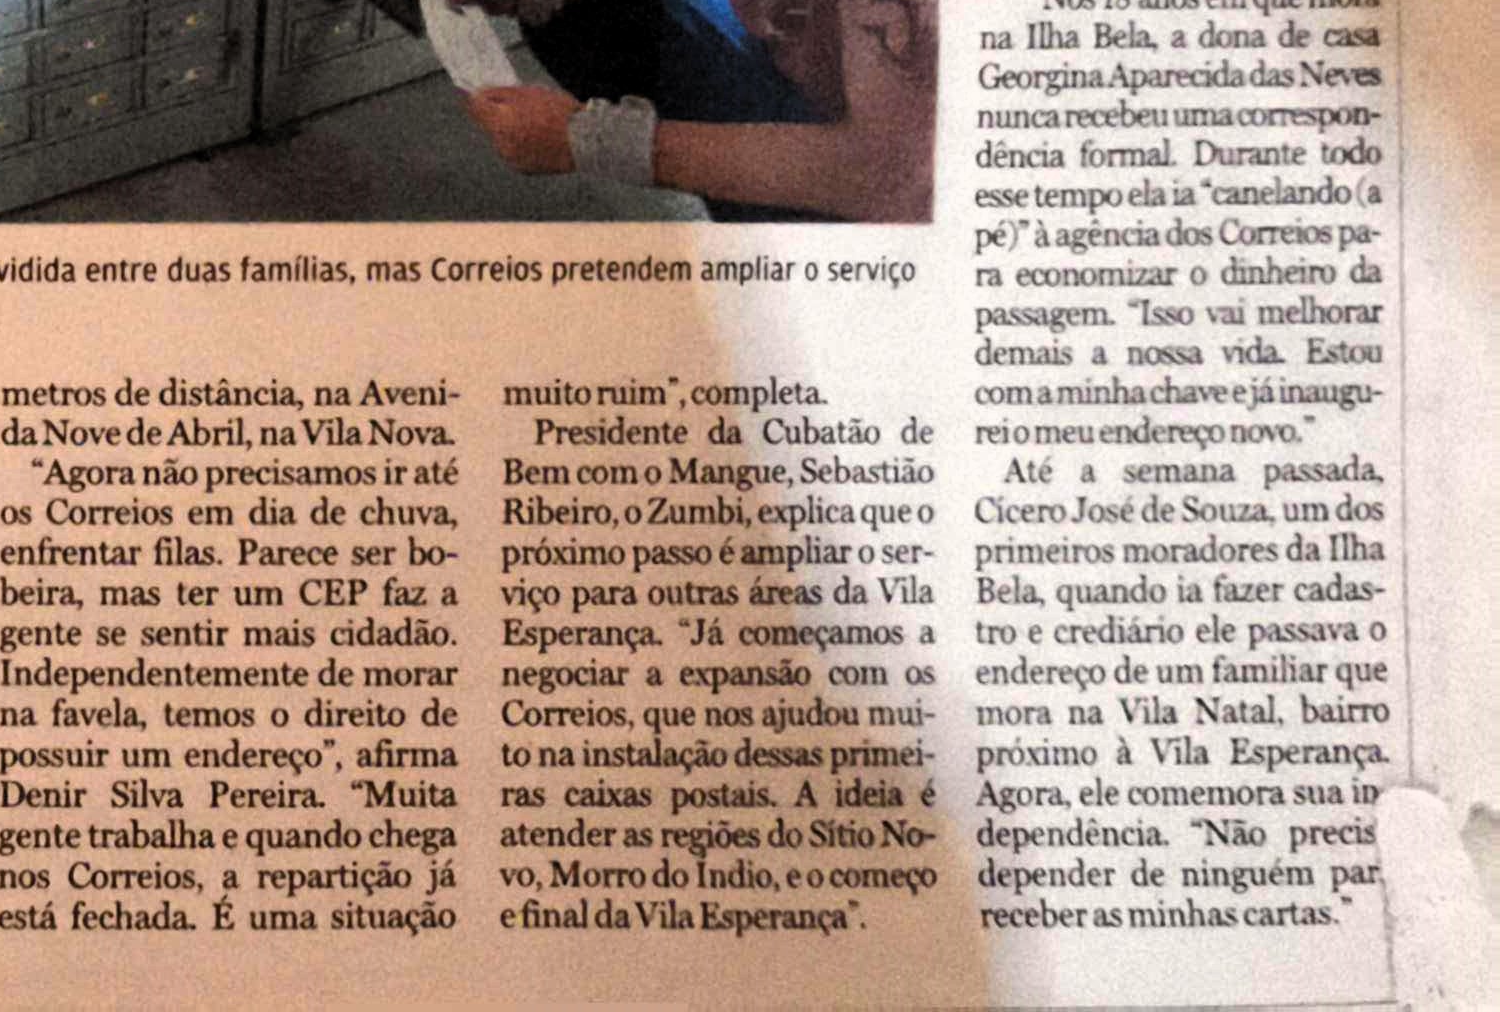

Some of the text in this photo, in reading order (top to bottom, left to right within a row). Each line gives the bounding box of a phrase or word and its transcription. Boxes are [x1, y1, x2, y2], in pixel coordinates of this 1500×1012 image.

[974, 136, 1383, 169] dência formal. Durante todo
[84, 259, 158, 283] entre
[166, 255, 232, 284] duas
[239, 254, 356, 285] famílias,
[366, 261, 422, 283] mas
[430, 254, 543, 283] Correios
[551, 254, 692, 286] pretendem
[700, 254, 797, 287] ampliar
[804, 261, 820, 282] o
[827, 255, 916, 290] serviço
[534, 414, 935, 446] Presidente da Cubatão de
[0, 495, 458, 530] os Correios em dia de chuva,
[500, 574, 935, 615] viço para outras áreas da Vila
[501, 657, 937, 696] negociar a expansão com os
[975, 693, 1391, 727] mora na Vila Natal, bairro
[121, 747, 172, 769] um
[356, 737, 459, 769] afirma
[0, 779, 88, 809] Denir
[110, 777, 185, 809] Silva
[209, 779, 326, 809] Pereira.
[71, 899, 197, 931] fechada.
[212, 894, 236, 931] É
[249, 909, 318, 931] uma
[330, 900, 457, 938] situação
[980, 897, 1089, 929] receber
[1092, 907, 1124, 929] as
[1127, 897, 1239, 929] minhas
